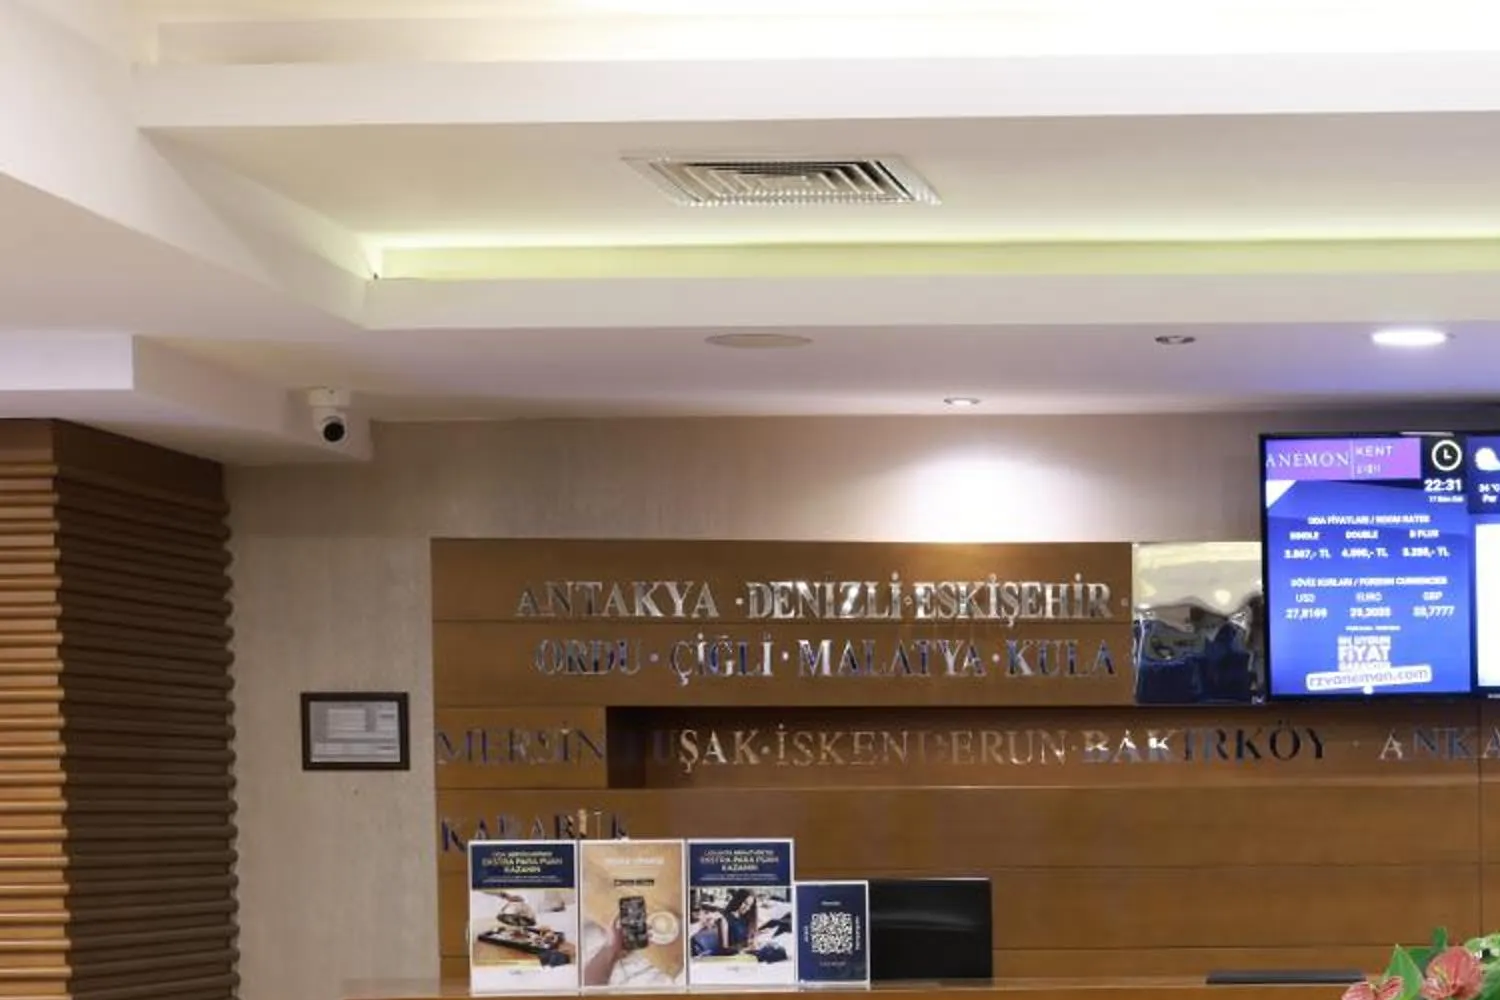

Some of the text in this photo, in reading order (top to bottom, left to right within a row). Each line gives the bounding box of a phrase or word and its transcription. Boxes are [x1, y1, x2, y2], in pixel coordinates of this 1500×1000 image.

[1266, 452, 1350, 468] ANEMON
[1354, 445, 1393, 457] KENT
[1424, 479, 1462, 492] 22:31
[515, 581, 719, 617] ANTAKYA
[912, 572, 1113, 627] ESKİŞEHİR
[534, 638, 642, 676] ORDU
[799, 639, 986, 677] MALATYA
[1005, 639, 1117, 677] KULA
[776, 722, 1067, 766] İSKENDERUN
[1082, 721, 1327, 763] BAKIRKÖY
